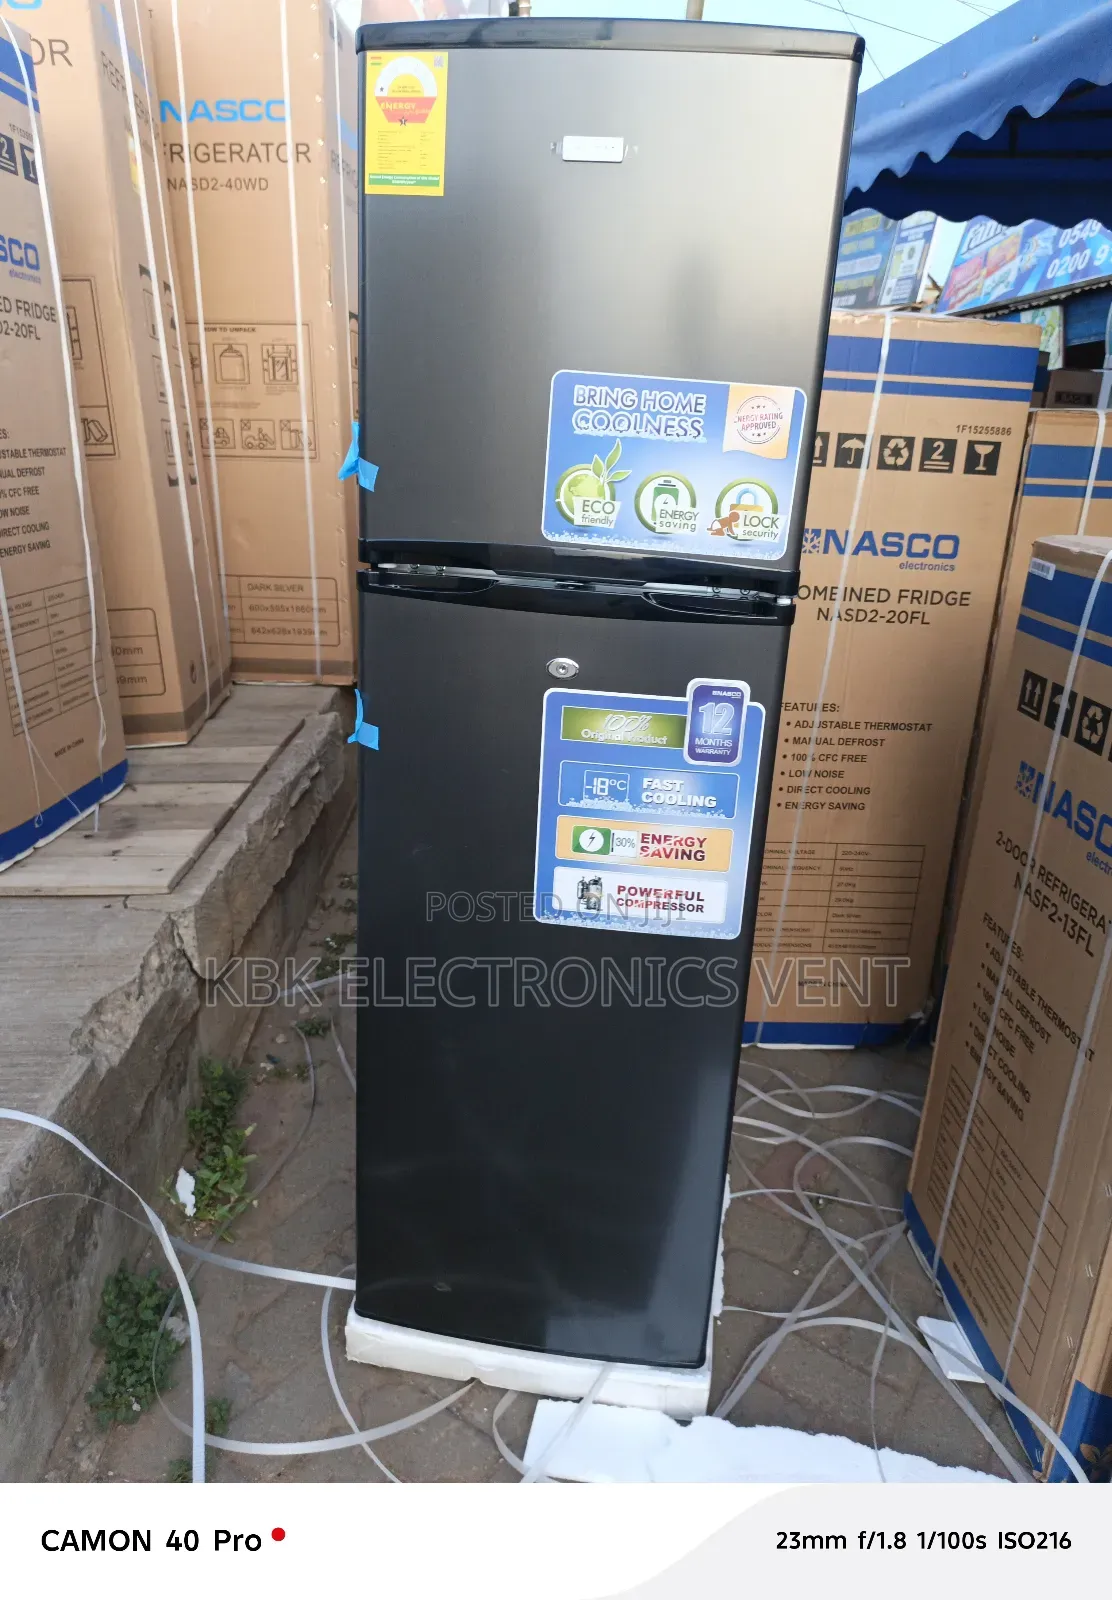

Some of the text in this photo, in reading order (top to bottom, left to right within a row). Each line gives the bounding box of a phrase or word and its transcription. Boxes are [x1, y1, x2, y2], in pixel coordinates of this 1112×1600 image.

[164, 142, 312, 163] RIGERATOR
[167, 177, 269, 191] NASD2-40WD
[1058, 219, 1101, 249] 0549
[1046, 248, 1092, 279] 0200
[15, 299, 57, 323] FRIDGE
[574, 385, 706, 415] BRING HOME
[572, 408, 704, 438] COOLNESS
[734, 411, 784, 424] NERGY RATING
[741, 421, 777, 431] APPROVED
[955, 424, 1012, 436] 1F15255886
[28, 447, 67, 458] THERMOSTAT
[16, 466, 46, 478] DEFROST
[8, 488, 22, 498] CFC
[23, 486, 40, 497] FREE
[9, 505, 30, 517] NOISE
[581, 499, 616, 513] ECO
[581, 513, 615, 527] friendly
[659, 509, 700, 522] ENERGY
[743, 514, 780, 530] LOCK
[21, 521, 50, 535] COOLING
[658, 519, 697, 533] saving
[742, 527, 779, 540] security
[0, 540, 51, 559] ENERGY SAVING
[822, 529, 961, 560] NASCO
[898, 560, 955, 572] electronics
[897, 589, 972, 607] FRIDGE
[603, 713, 653, 733] 100%
[698, 702, 735, 736] 12
[864, 721, 933, 732] THERMOSTAT
[581, 728, 624, 742] Original
[694, 737, 733, 748] MONTHS
[837, 738, 885, 747] DEFROST
[694, 747, 732, 756] WARRANTY
[818, 754, 838, 762] CFC
[840, 754, 868, 763] FREE
[814, 770, 845, 779] NOISE
[641, 776, 685, 794] FAST
[825, 786, 871, 795] COOLING
[641, 791, 718, 809] COOLING
[827, 802, 866, 811] SAVING
[615, 836, 636, 849] 30%
[640, 832, 708, 849] ENERGY
[639, 846, 706, 862] SAVING
[616, 885, 705, 902] POWERFUL
[1037, 864, 1112, 935] REFRIGERA
[615, 897, 705, 913] COMPRESSOR
[1013, 871, 1095, 958] NASF2-13FL
[989, 947, 1096, 1063] ADJSTABLE THERMOSTT
[1015, 999, 1052, 1045] DEFROST
[999, 1007, 1014, 1030] CFC
[1014, 1024, 1036, 1055] FREE
[997, 1057, 1032, 1104] COOLING
